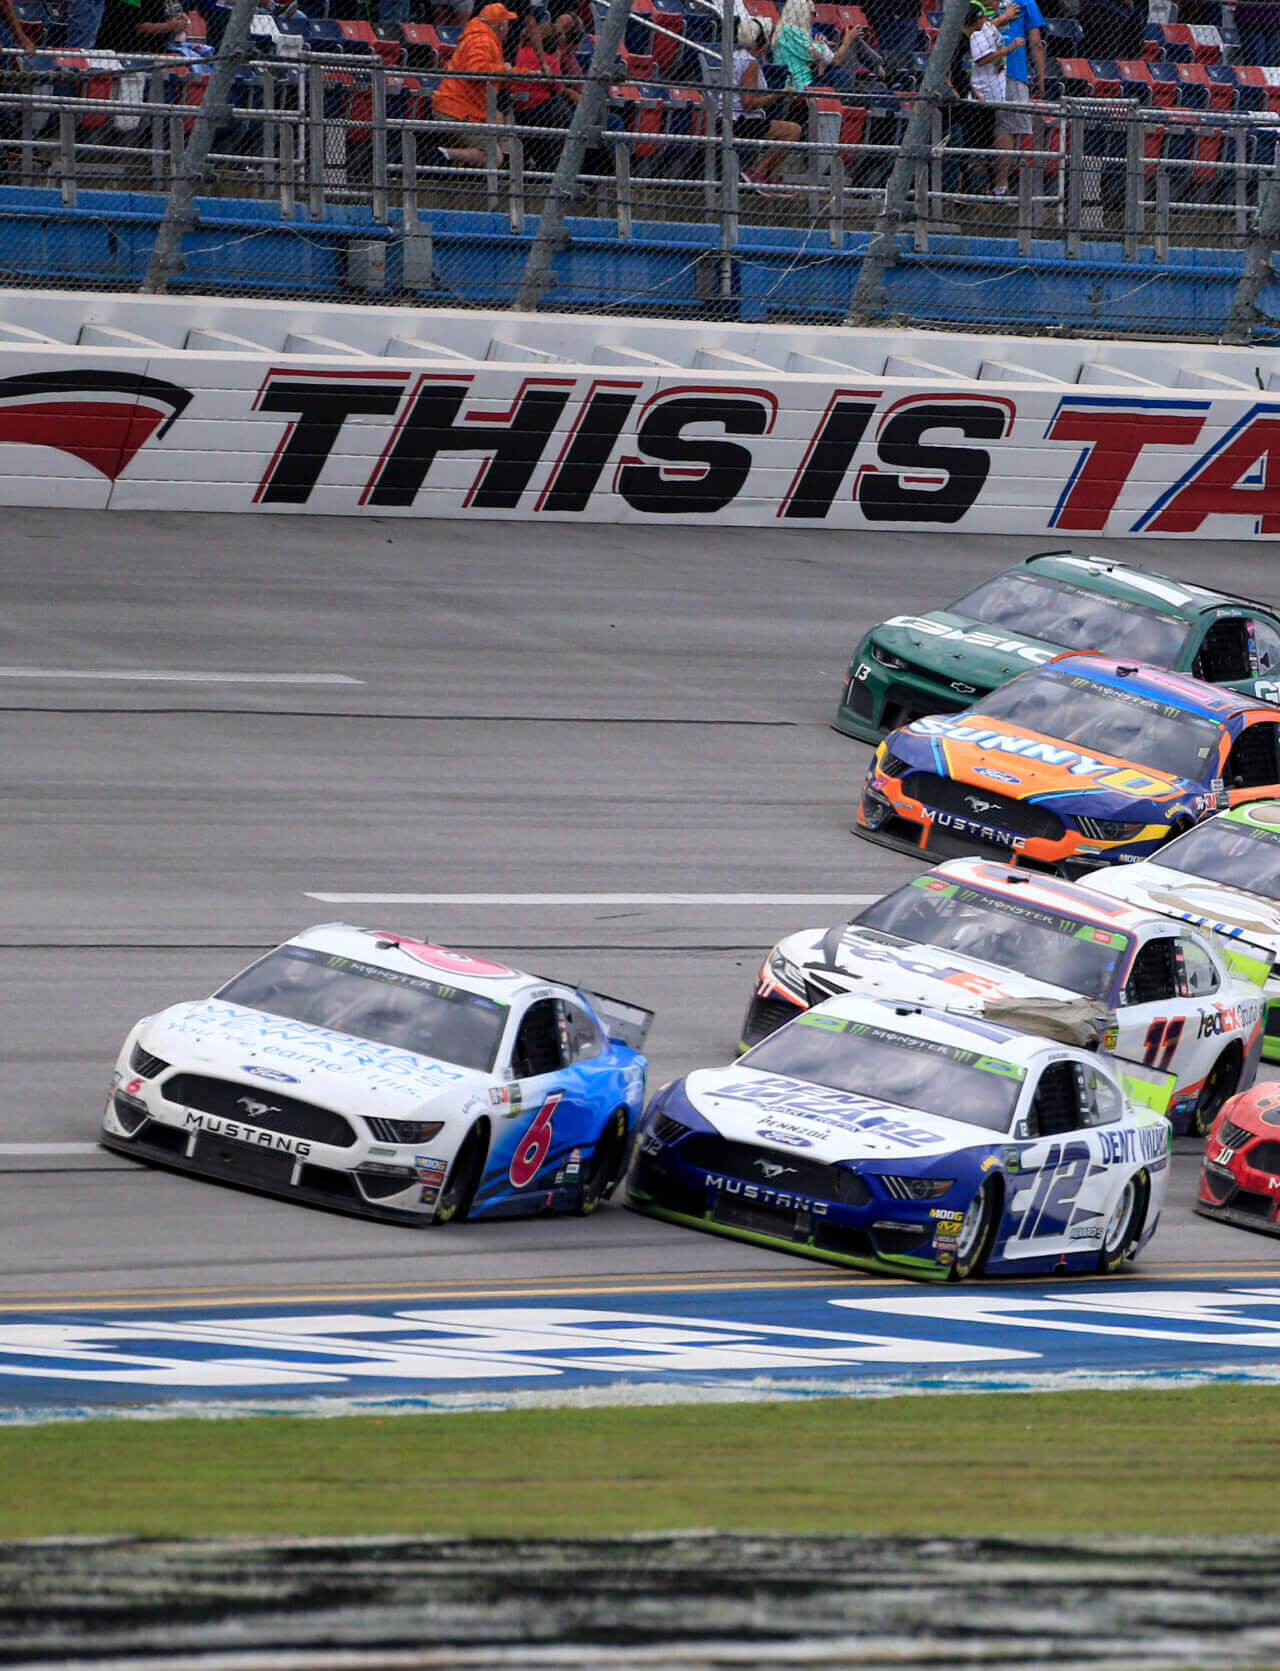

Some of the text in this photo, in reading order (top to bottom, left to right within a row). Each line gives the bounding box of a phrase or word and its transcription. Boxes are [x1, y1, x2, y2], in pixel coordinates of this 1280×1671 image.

[252, 368, 778, 514] THIS
[777, 389, 1016, 524] IS
[883, 615, 1060, 664] GEIC
[855, 663, 873, 681] 13
[1090, 683, 1160, 710] MONSTER
[920, 807, 1027, 849] MUSTANG
[981, 896, 1054, 925] MONSTER
[351, 962, 432, 990] MONSTER
[1197, 1003, 1241, 1040] FedEx
[184, 1014, 442, 1088] REWARDS
[207, 1004, 463, 1080] WYNDHAM
[871, 1029, 948, 1055] MONSTER
[1143, 1015, 1187, 1071] 11
[126, 1079, 144, 1094] 6
[714, 1083, 947, 1144] WIZARD
[757, 1116, 831, 1141] PENNZOIL
[186, 1112, 311, 1157] MUSTANG
[509, 1089, 565, 1188] 6
[1096, 1128, 1136, 1165] DENT
[1213, 1147, 1235, 1166] 10
[705, 1174, 829, 1215] MUSTANG
[1017, 1140, 1091, 1240] 12
[929, 1208, 964, 1221] MOOG
